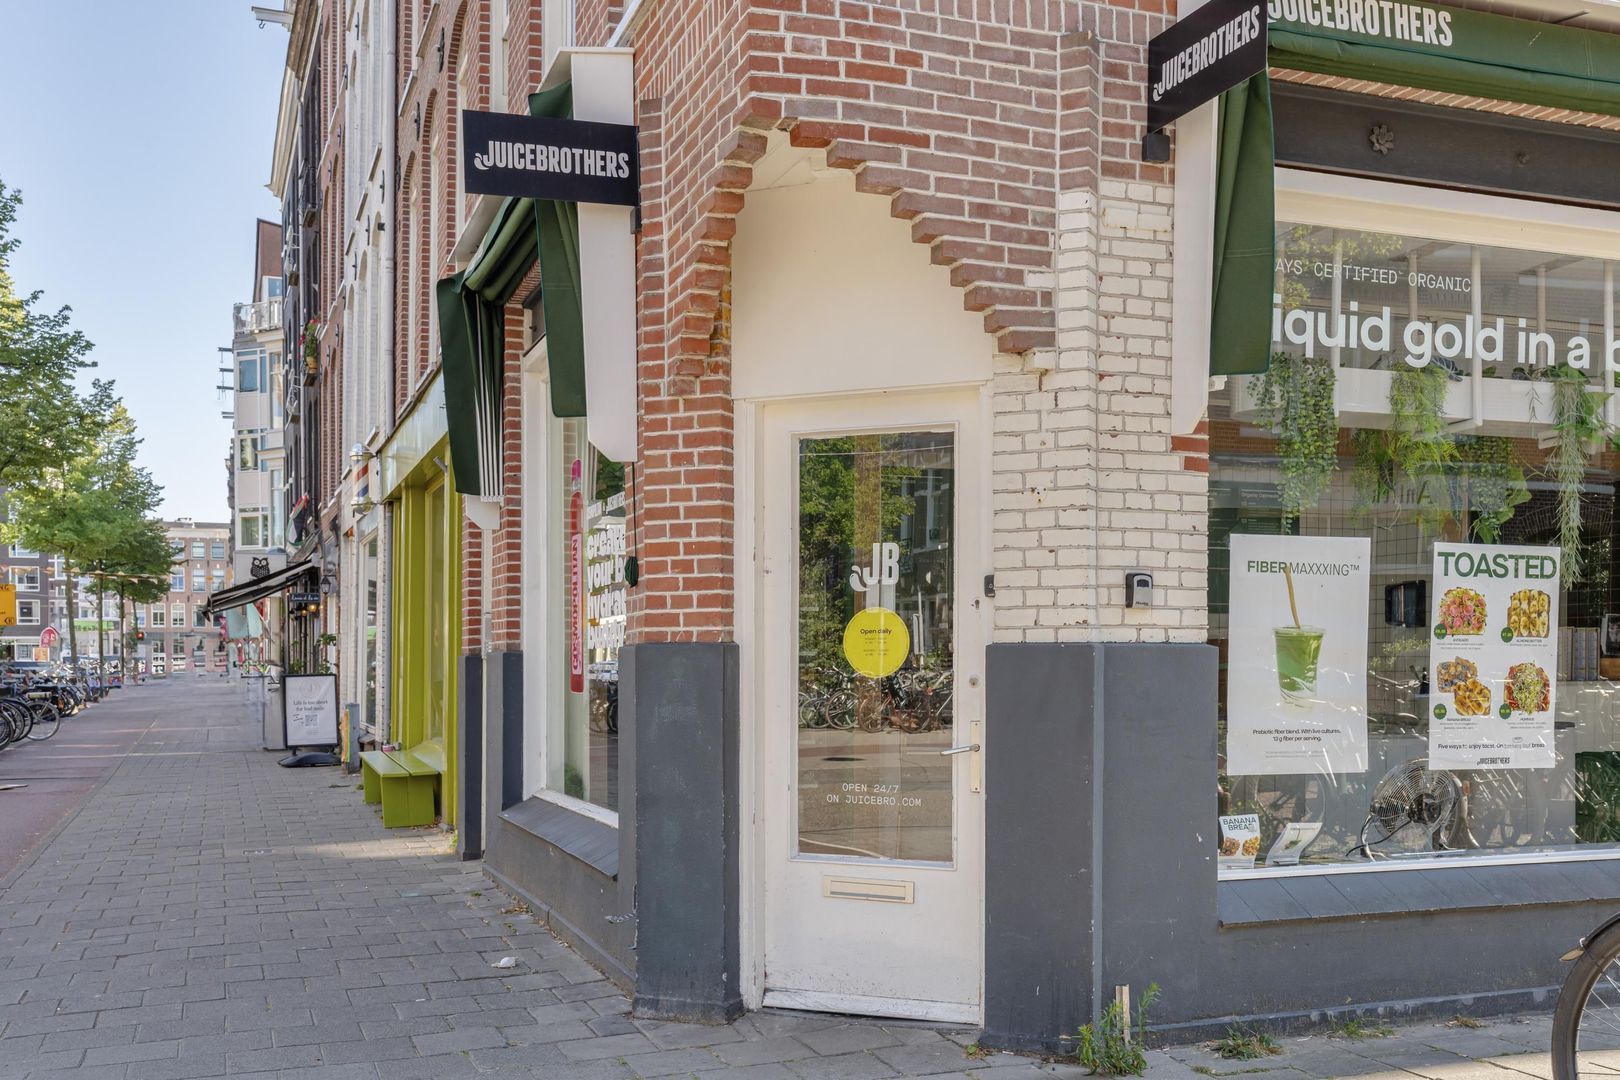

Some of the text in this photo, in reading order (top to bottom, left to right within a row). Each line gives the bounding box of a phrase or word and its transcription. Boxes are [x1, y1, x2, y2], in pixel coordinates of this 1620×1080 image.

[1152, 4, 1260, 102] JUICEBROTHERS
[474, 140, 629, 179] JUICEBROTHERS
[1314, 262, 1398, 285] CERTIFIED
[1408, 272, 1472, 293] ORGANIC
[1403, 315, 1505, 369] gold
[1517, 318, 1555, 366] in
[1567, 336, 1591, 369] a
[850, 542, 900, 592] JB
[1437, 551, 1557, 580] TOASTED
[826, 794, 922, 807] ON JUICEBRO.COM
[842, 783, 899, 794] OPEN 24/7
[1223, 817, 1257, 826] BANANA
[1228, 823, 1253, 831] BREA
